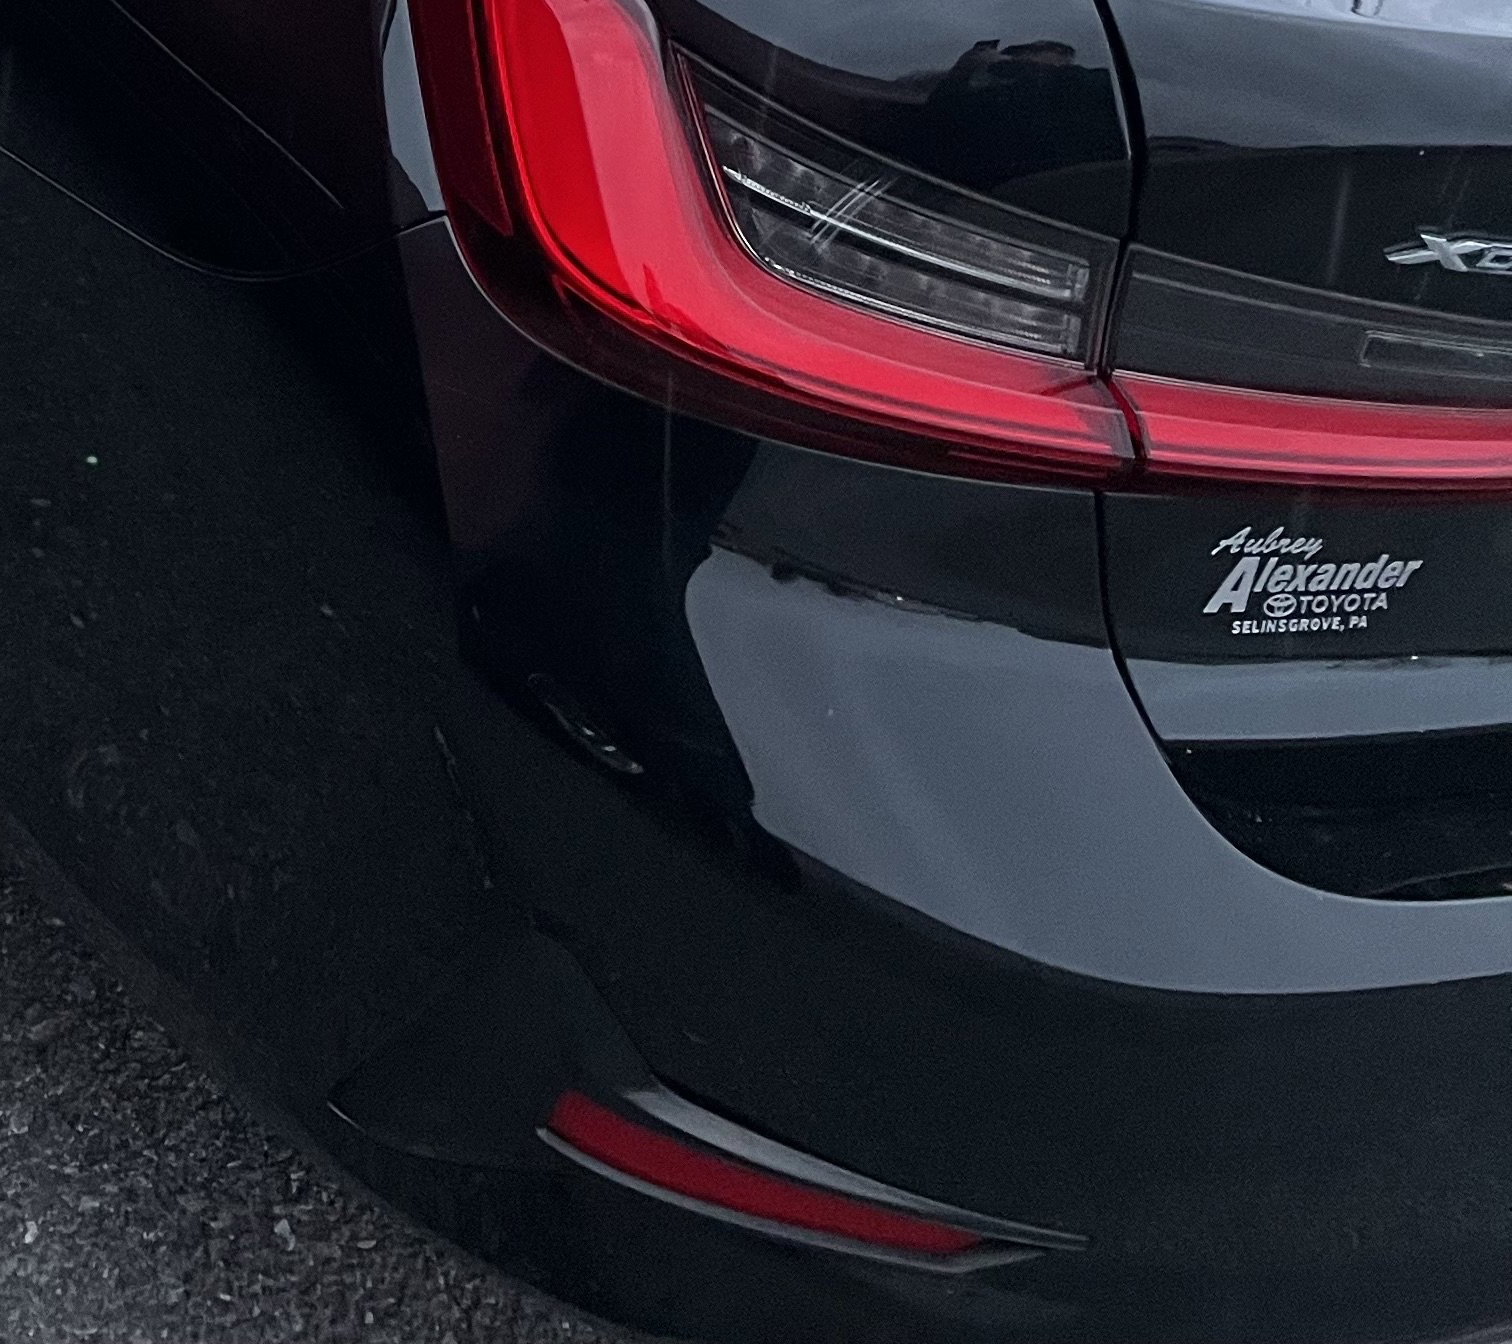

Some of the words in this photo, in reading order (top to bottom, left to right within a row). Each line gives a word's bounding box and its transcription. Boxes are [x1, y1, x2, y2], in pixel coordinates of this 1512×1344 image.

[1211, 526, 1323, 560] Aubrey
[1203, 554, 1424, 613] Alexander
[1300, 592, 1388, 614] TOYOTA
[1231, 616, 1345, 634] SELINSGROVE,
[1349, 615, 1368, 628] PA
